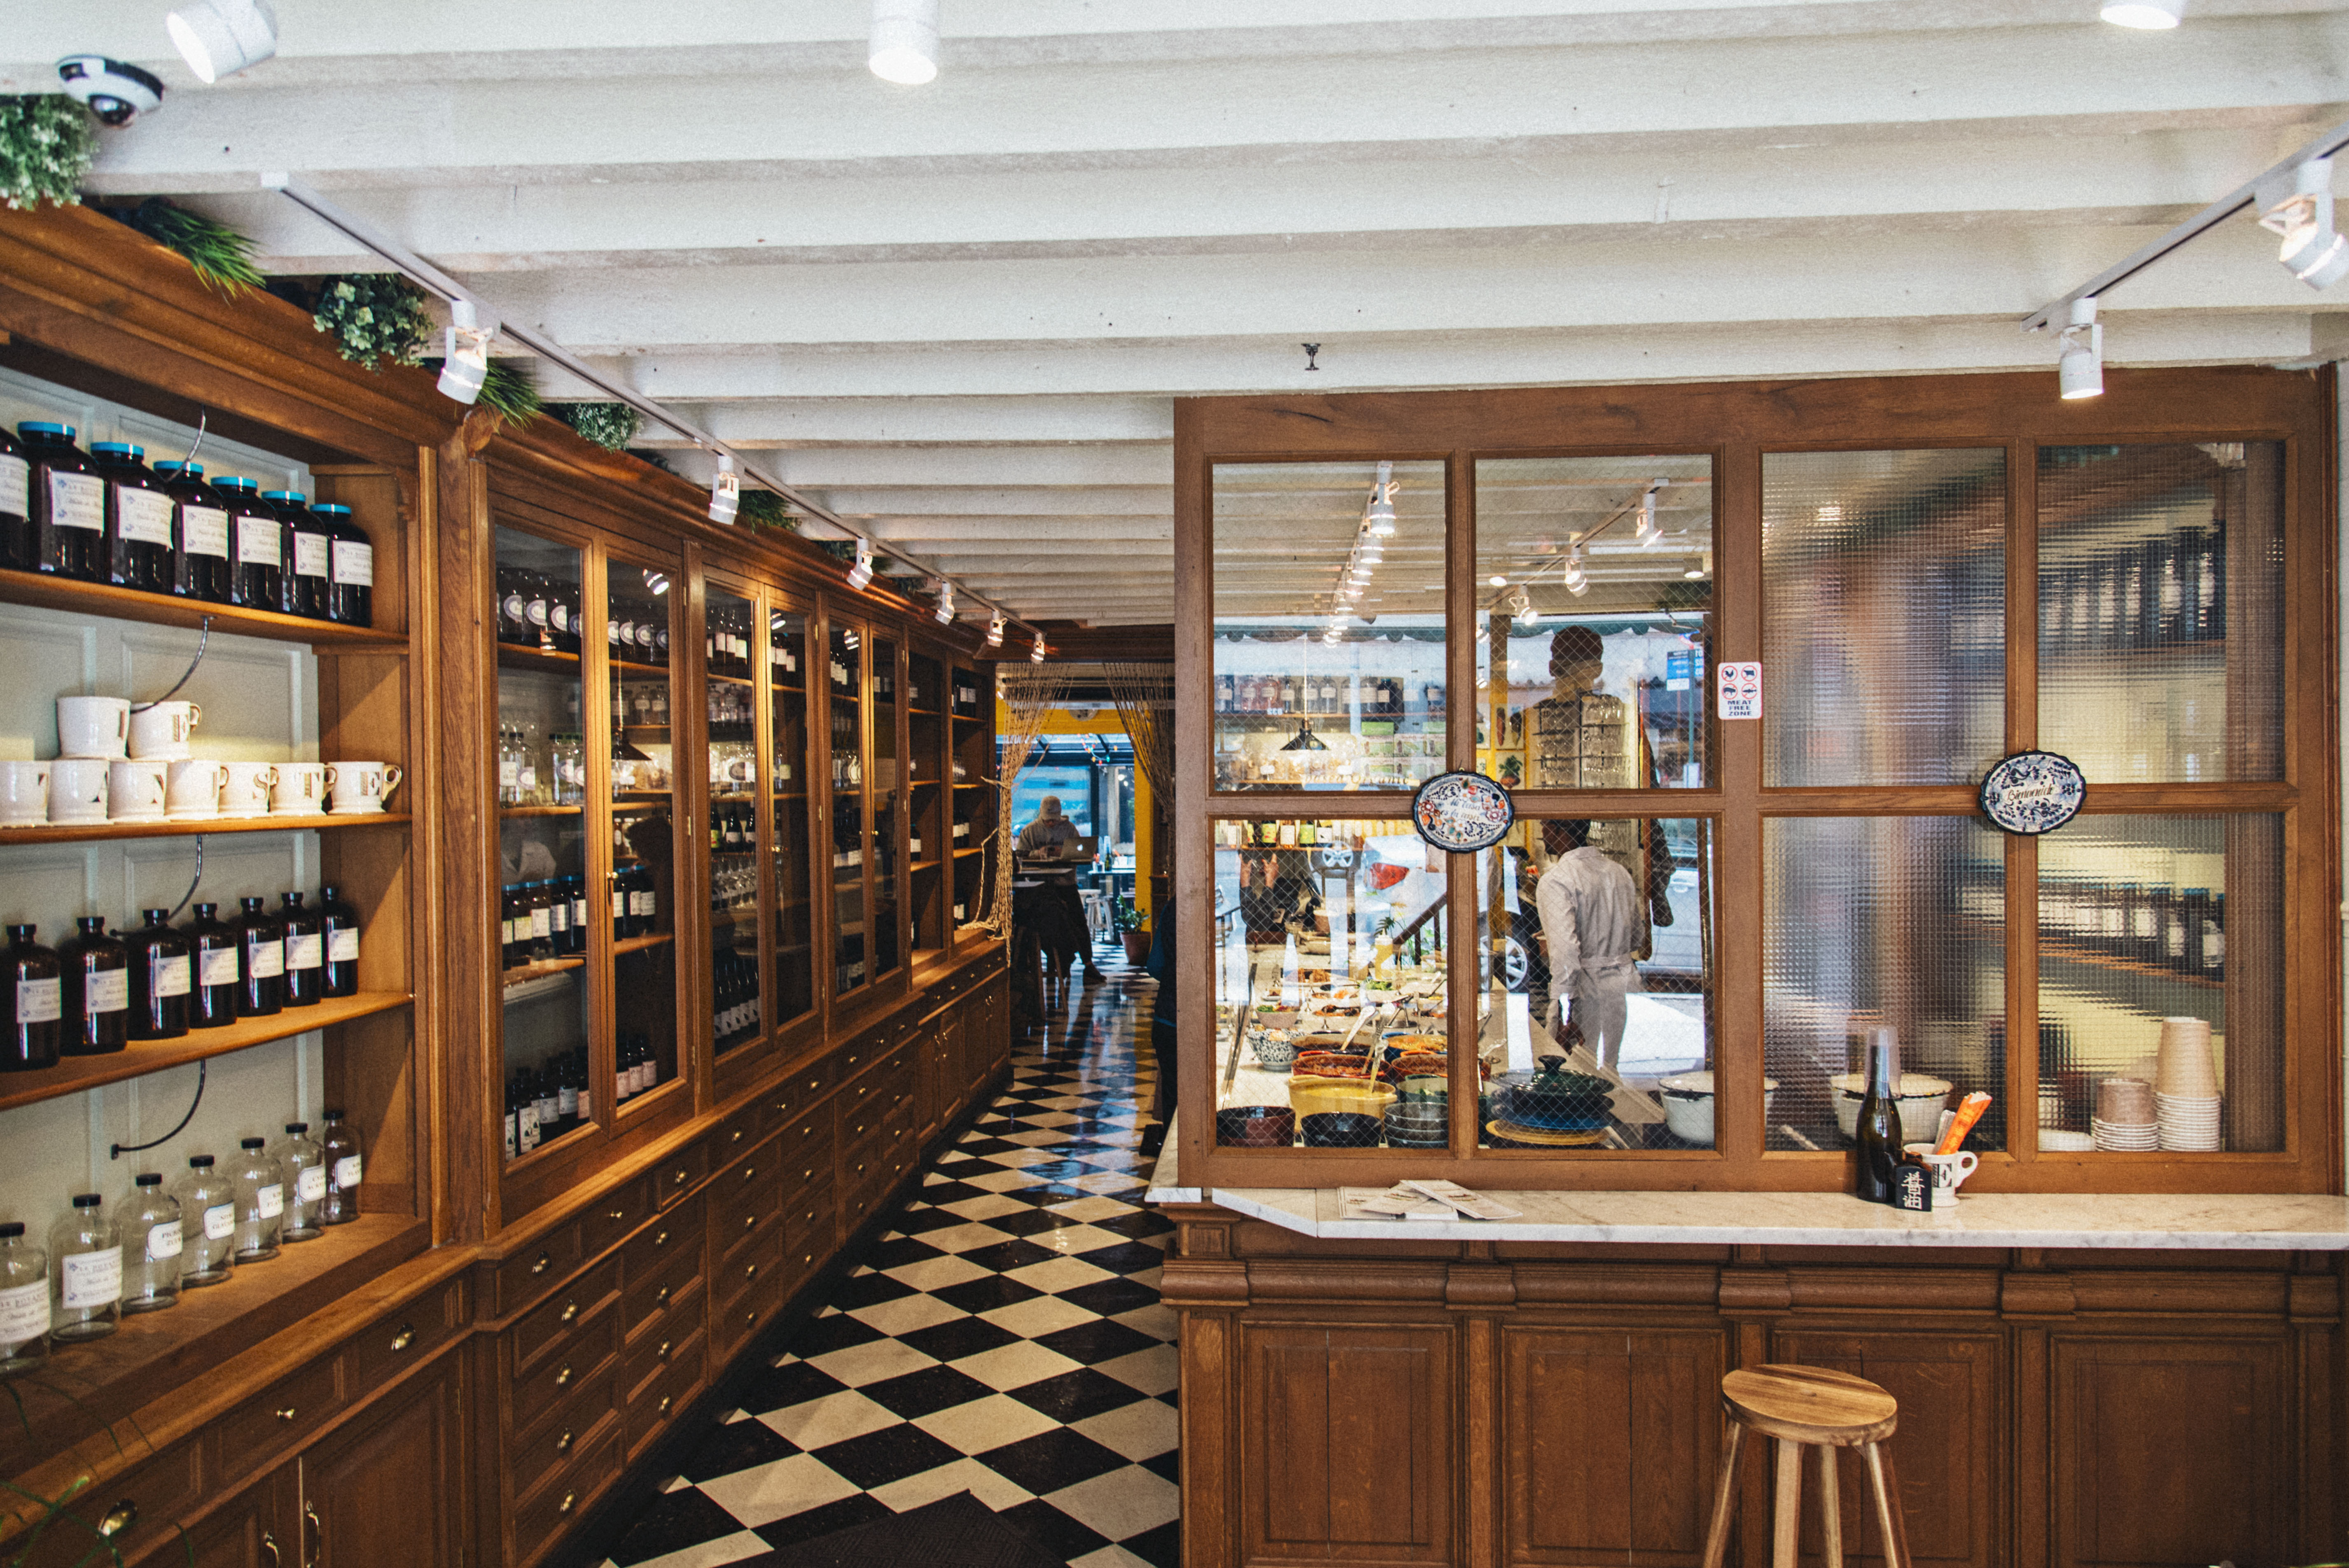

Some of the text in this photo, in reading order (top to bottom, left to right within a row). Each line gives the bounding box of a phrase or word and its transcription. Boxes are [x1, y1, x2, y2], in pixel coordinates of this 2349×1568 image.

[299, 772, 320, 798] T
[360, 771, 380, 796] E
[1932, 1163, 1952, 1188] E
